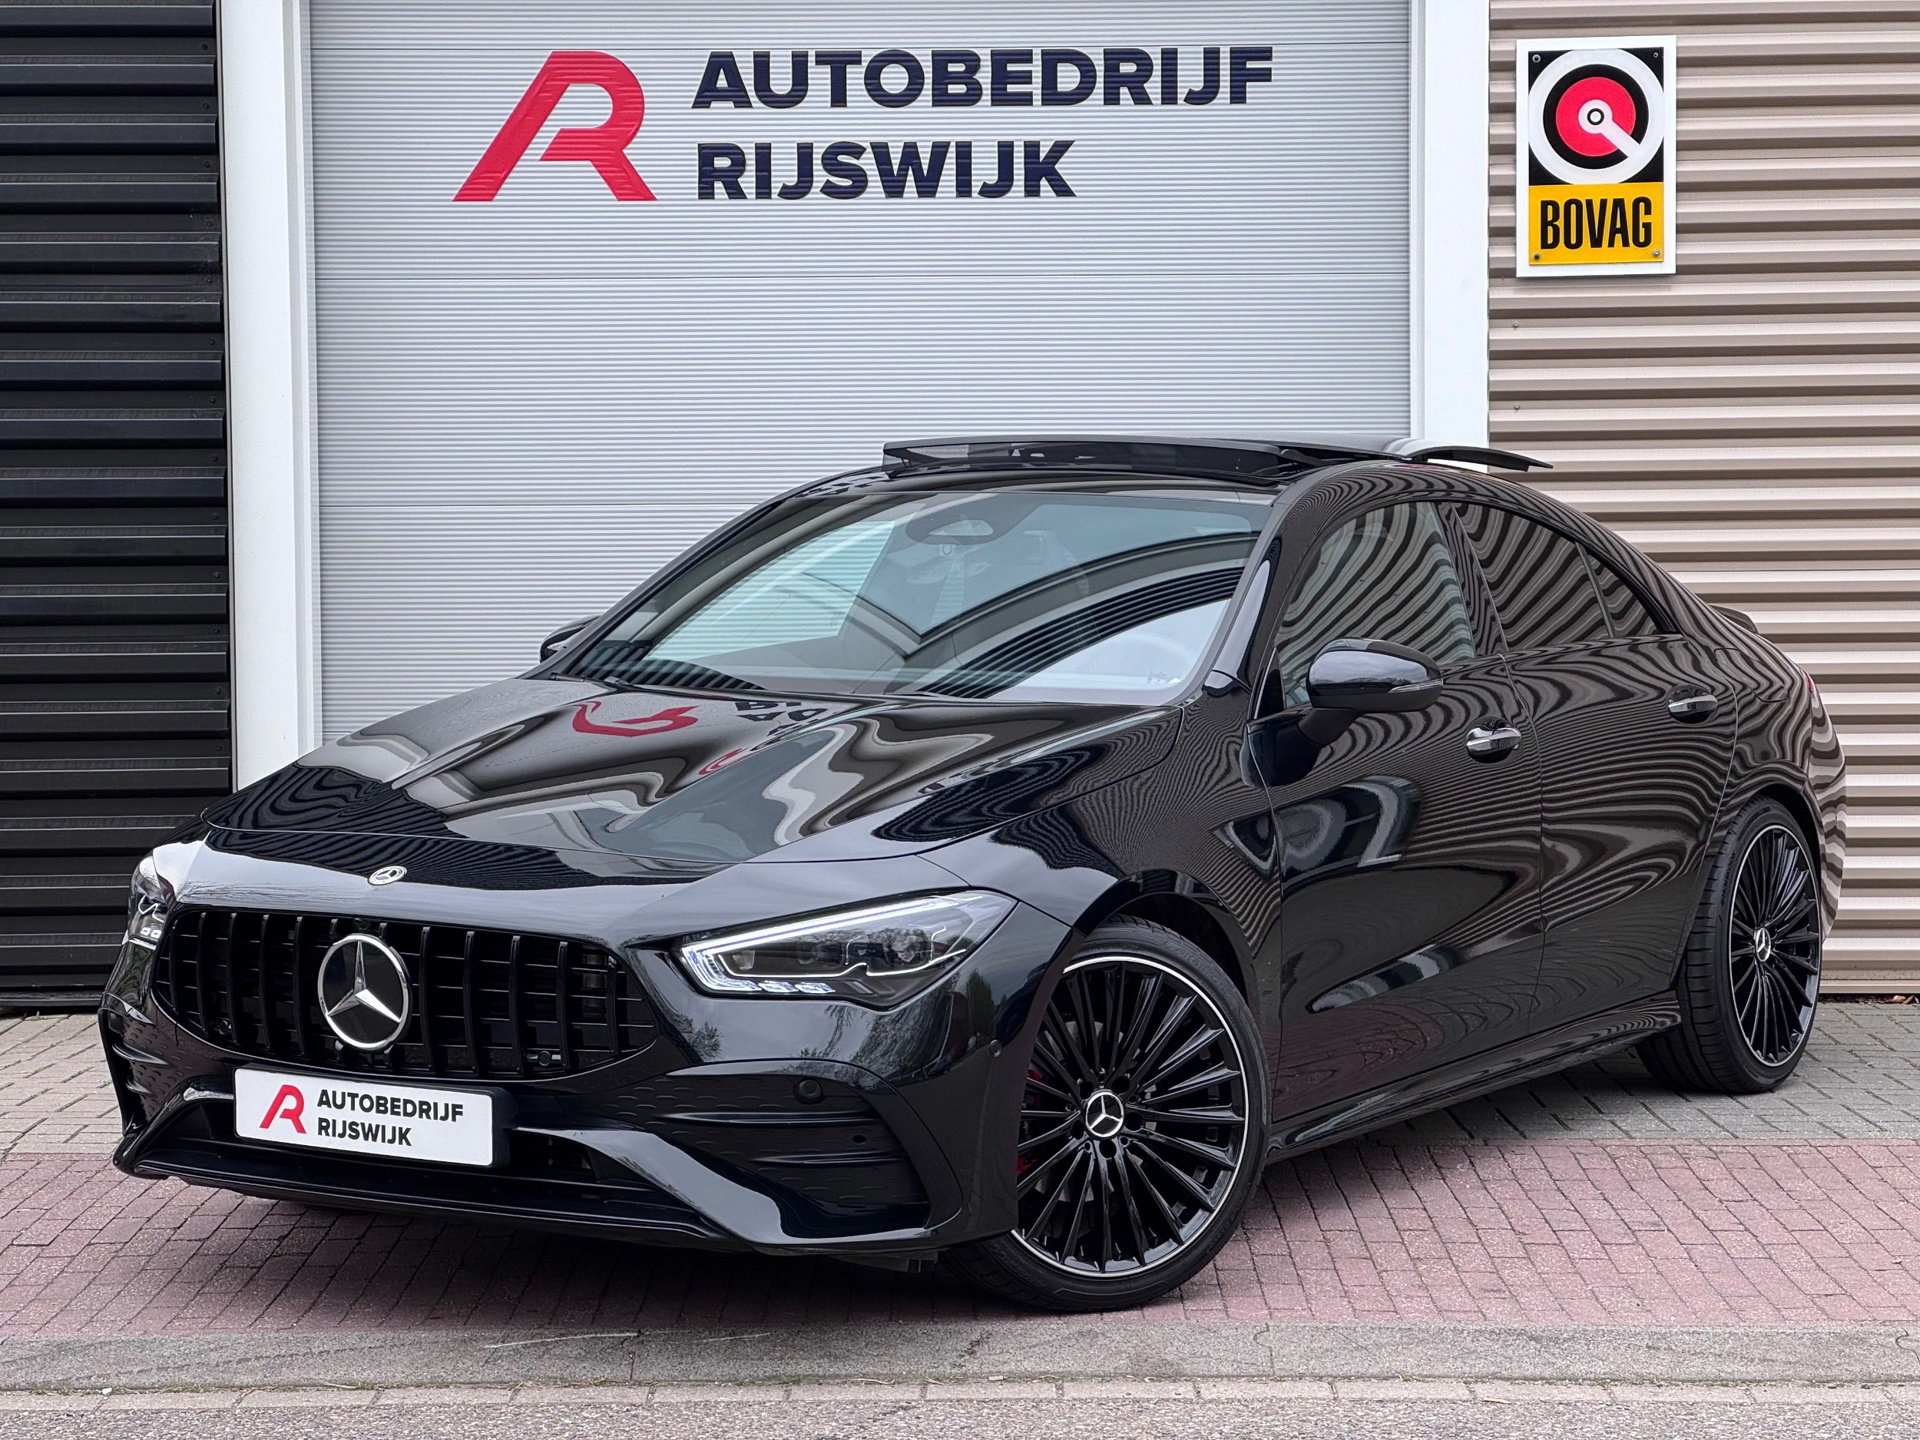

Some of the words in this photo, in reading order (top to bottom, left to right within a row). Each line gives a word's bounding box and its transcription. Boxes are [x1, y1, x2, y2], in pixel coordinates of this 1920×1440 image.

[691, 47, 1273, 108] AUTOBEDRIJF
[697, 140, 1076, 200] RIJSWIJK
[1540, 197, 1652, 250] BOVAG
[317, 1089, 463, 1122] AUTOBEDRIJF
[317, 1117, 412, 1146] RIJSWIJK
